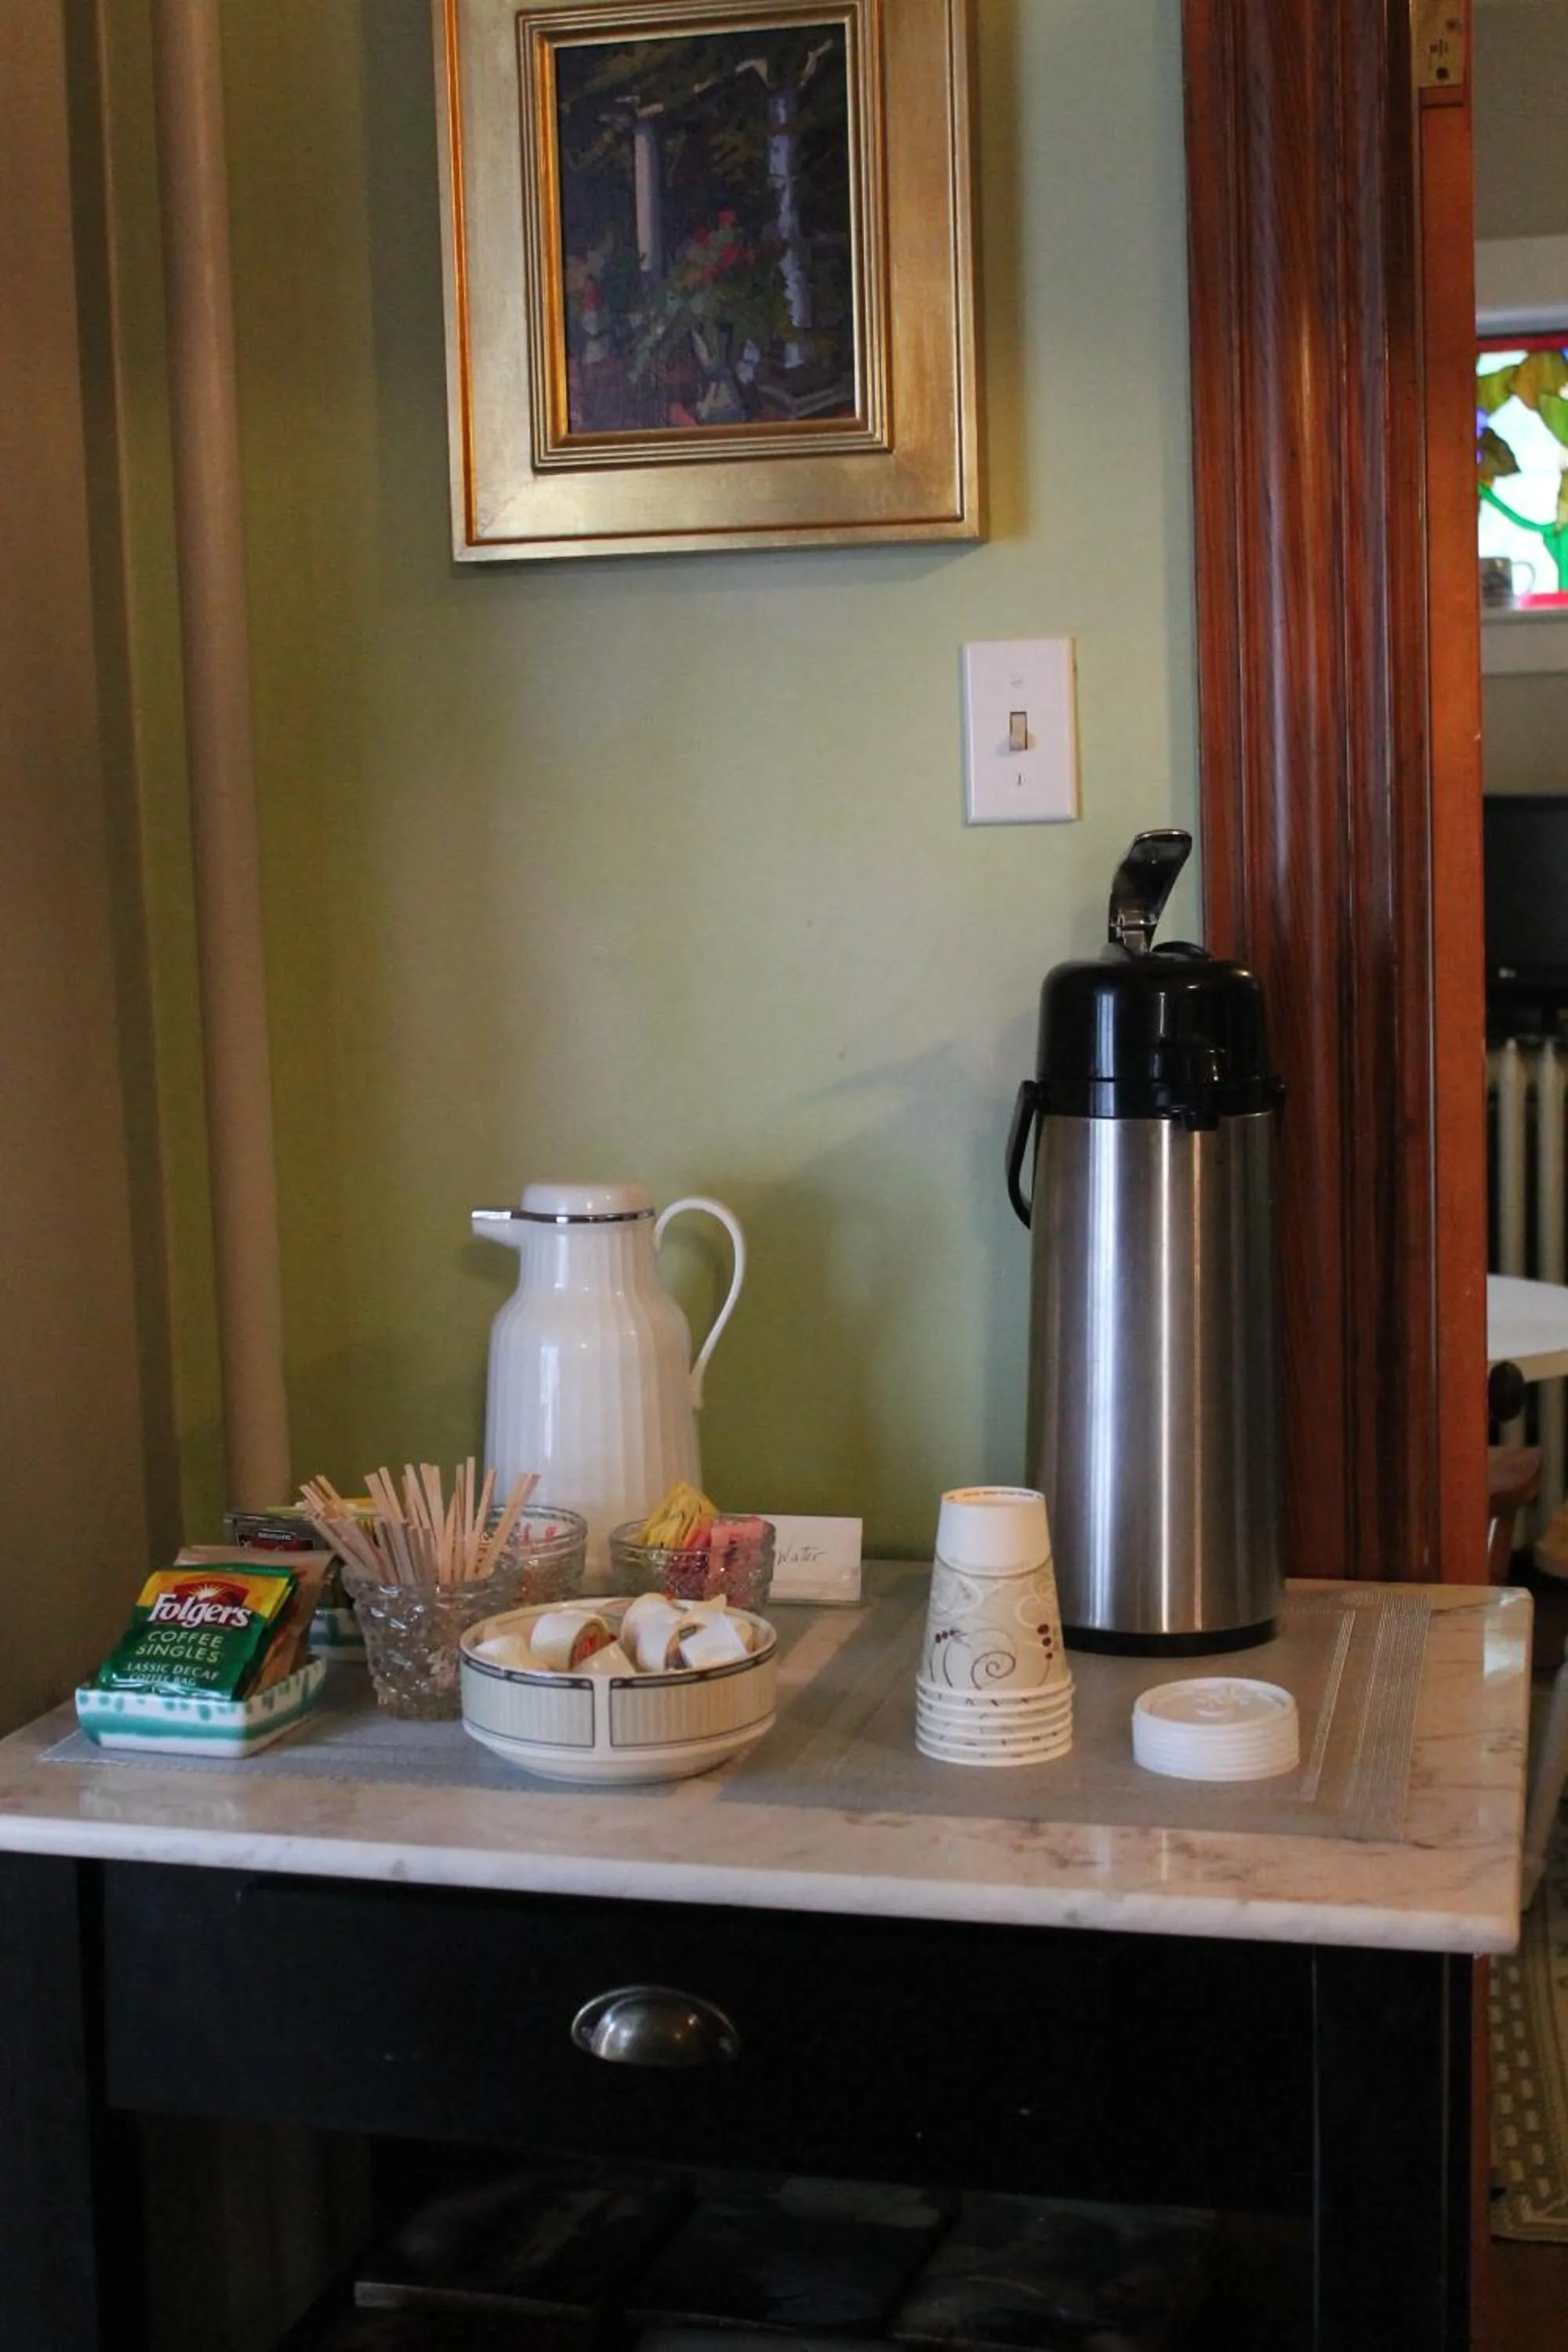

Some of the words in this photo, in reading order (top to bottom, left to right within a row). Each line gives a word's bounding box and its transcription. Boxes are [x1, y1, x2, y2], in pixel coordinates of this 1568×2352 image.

[147, 1592, 251, 1628] Folgers
[147, 1631, 223, 1648] COFFEE
[135, 1643, 220, 1663] SINGLES
[124, 1661, 171, 1673] LASSIC
